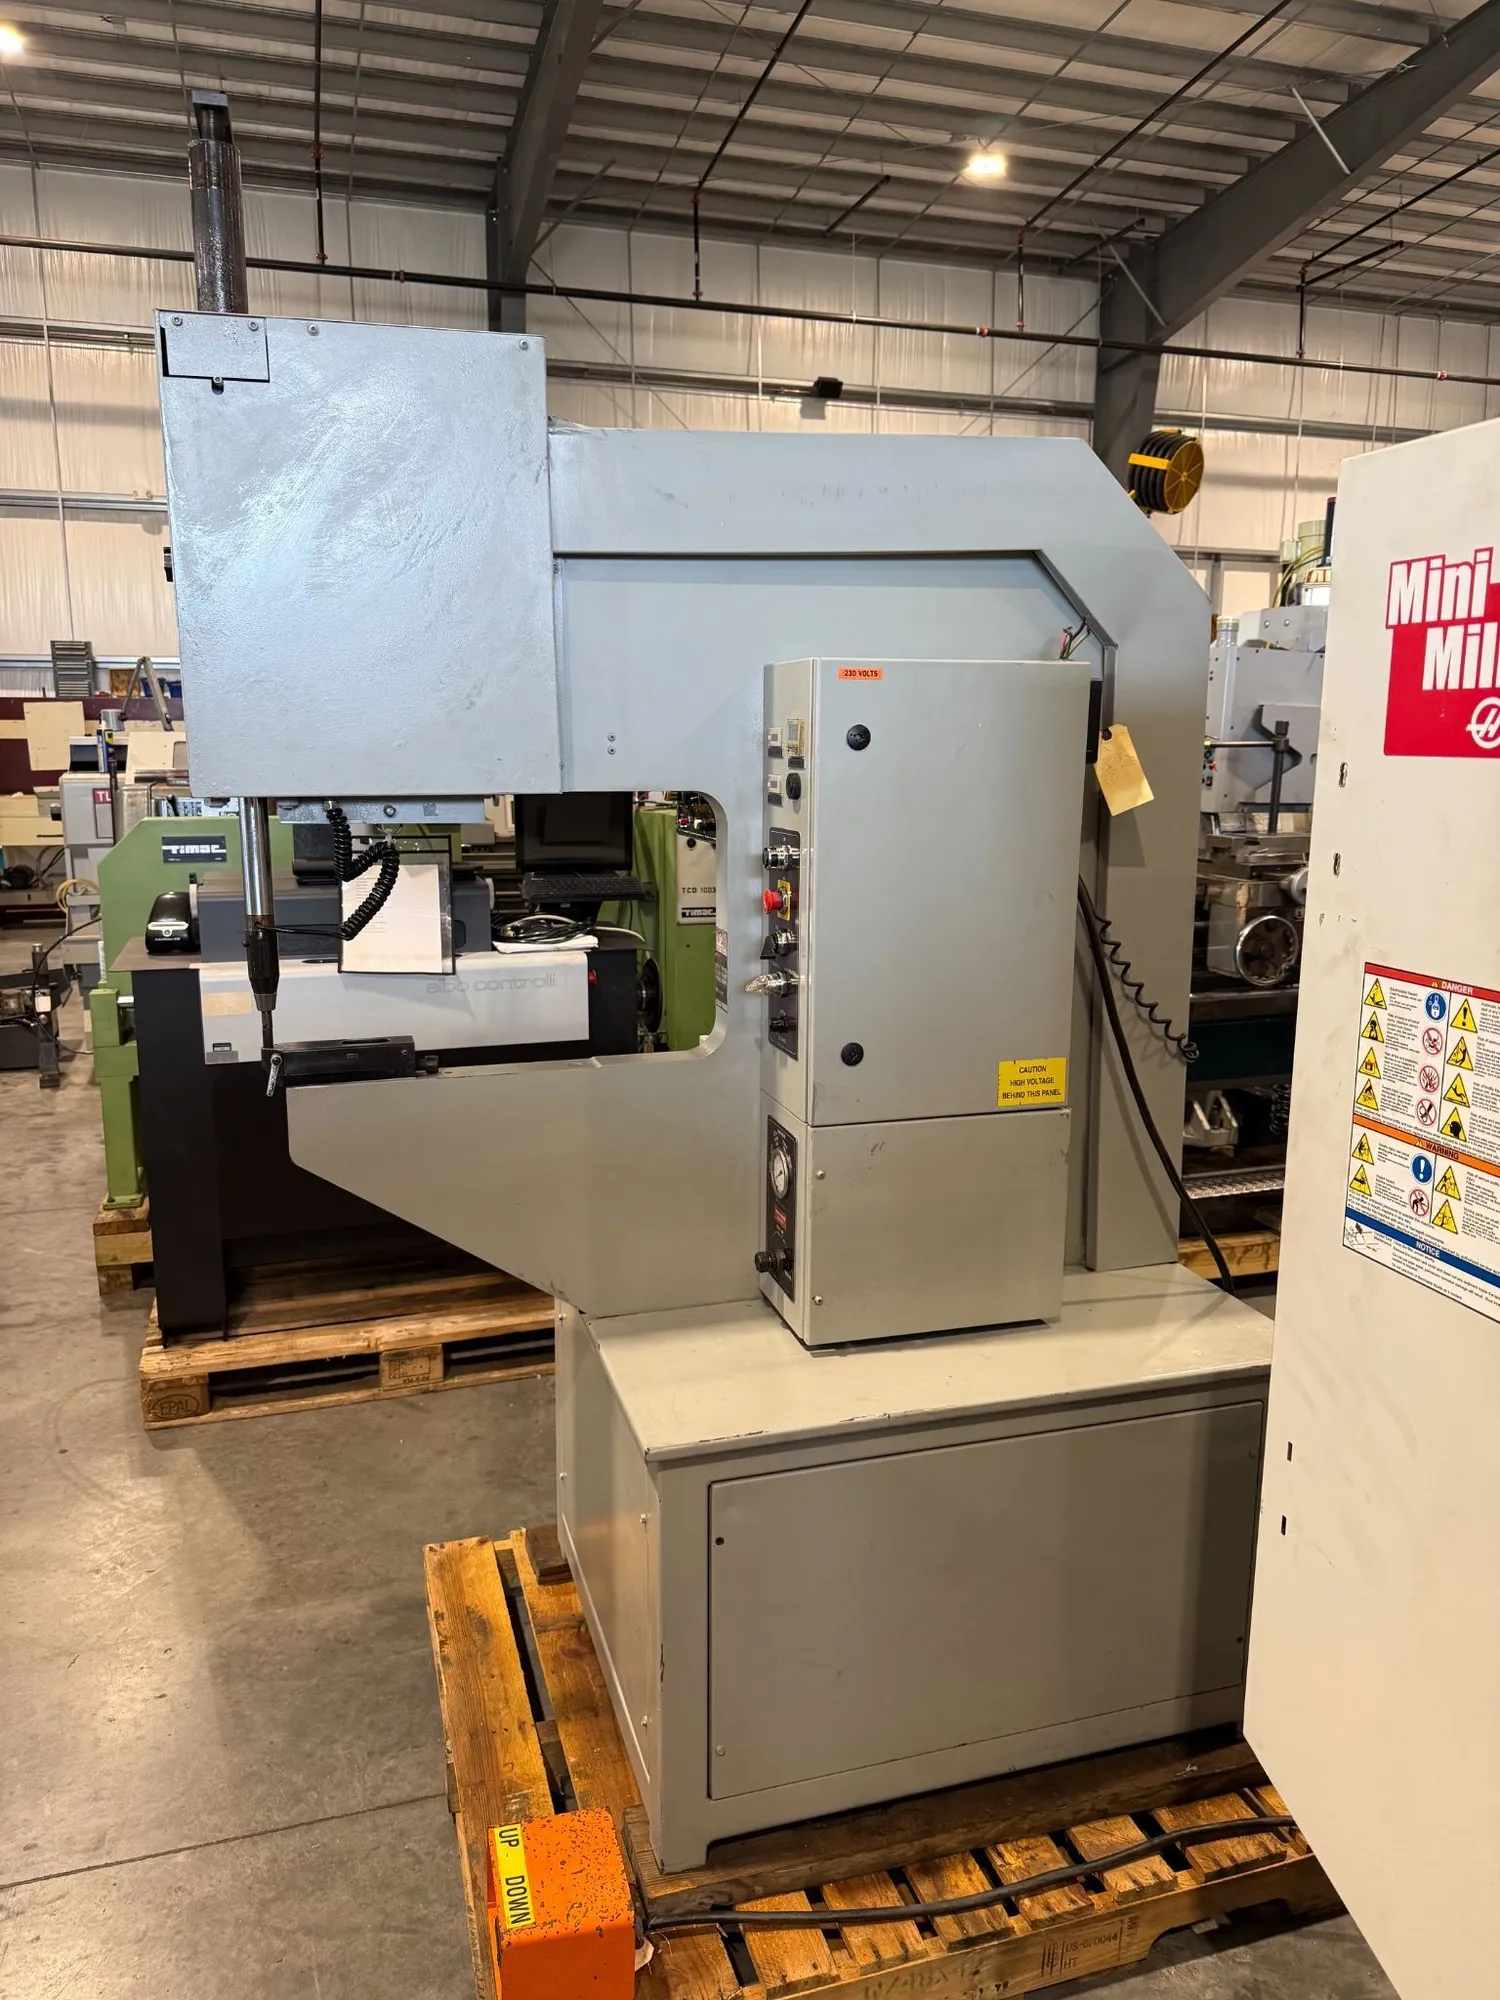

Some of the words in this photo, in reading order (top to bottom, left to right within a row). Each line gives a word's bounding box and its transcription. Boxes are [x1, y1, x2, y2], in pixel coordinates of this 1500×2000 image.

[1386, 547, 1493, 629] Mini
[1422, 621, 1500, 690] Mil
[844, 669, 857, 677] 230
[858, 669, 878, 678] VOLTS
[1441, 981, 1473, 995] DANGER
[1019, 1065, 1047, 1074] CAUTION
[1026, 1077, 1055, 1085] VOLTAGE
[1002, 1091, 1026, 1099] BEHIND
[1027, 1090, 1041, 1098] THIS
[1041, 1088, 1061, 1097] PANEL
[1425, 1140, 1459, 1160] WARNING
[1415, 1240, 1441, 1258] NOTICE
[160, 1399, 195, 1416] EPAL
[498, 1827, 520, 1848] UP
[505, 1876, 532, 1925] DOWN
